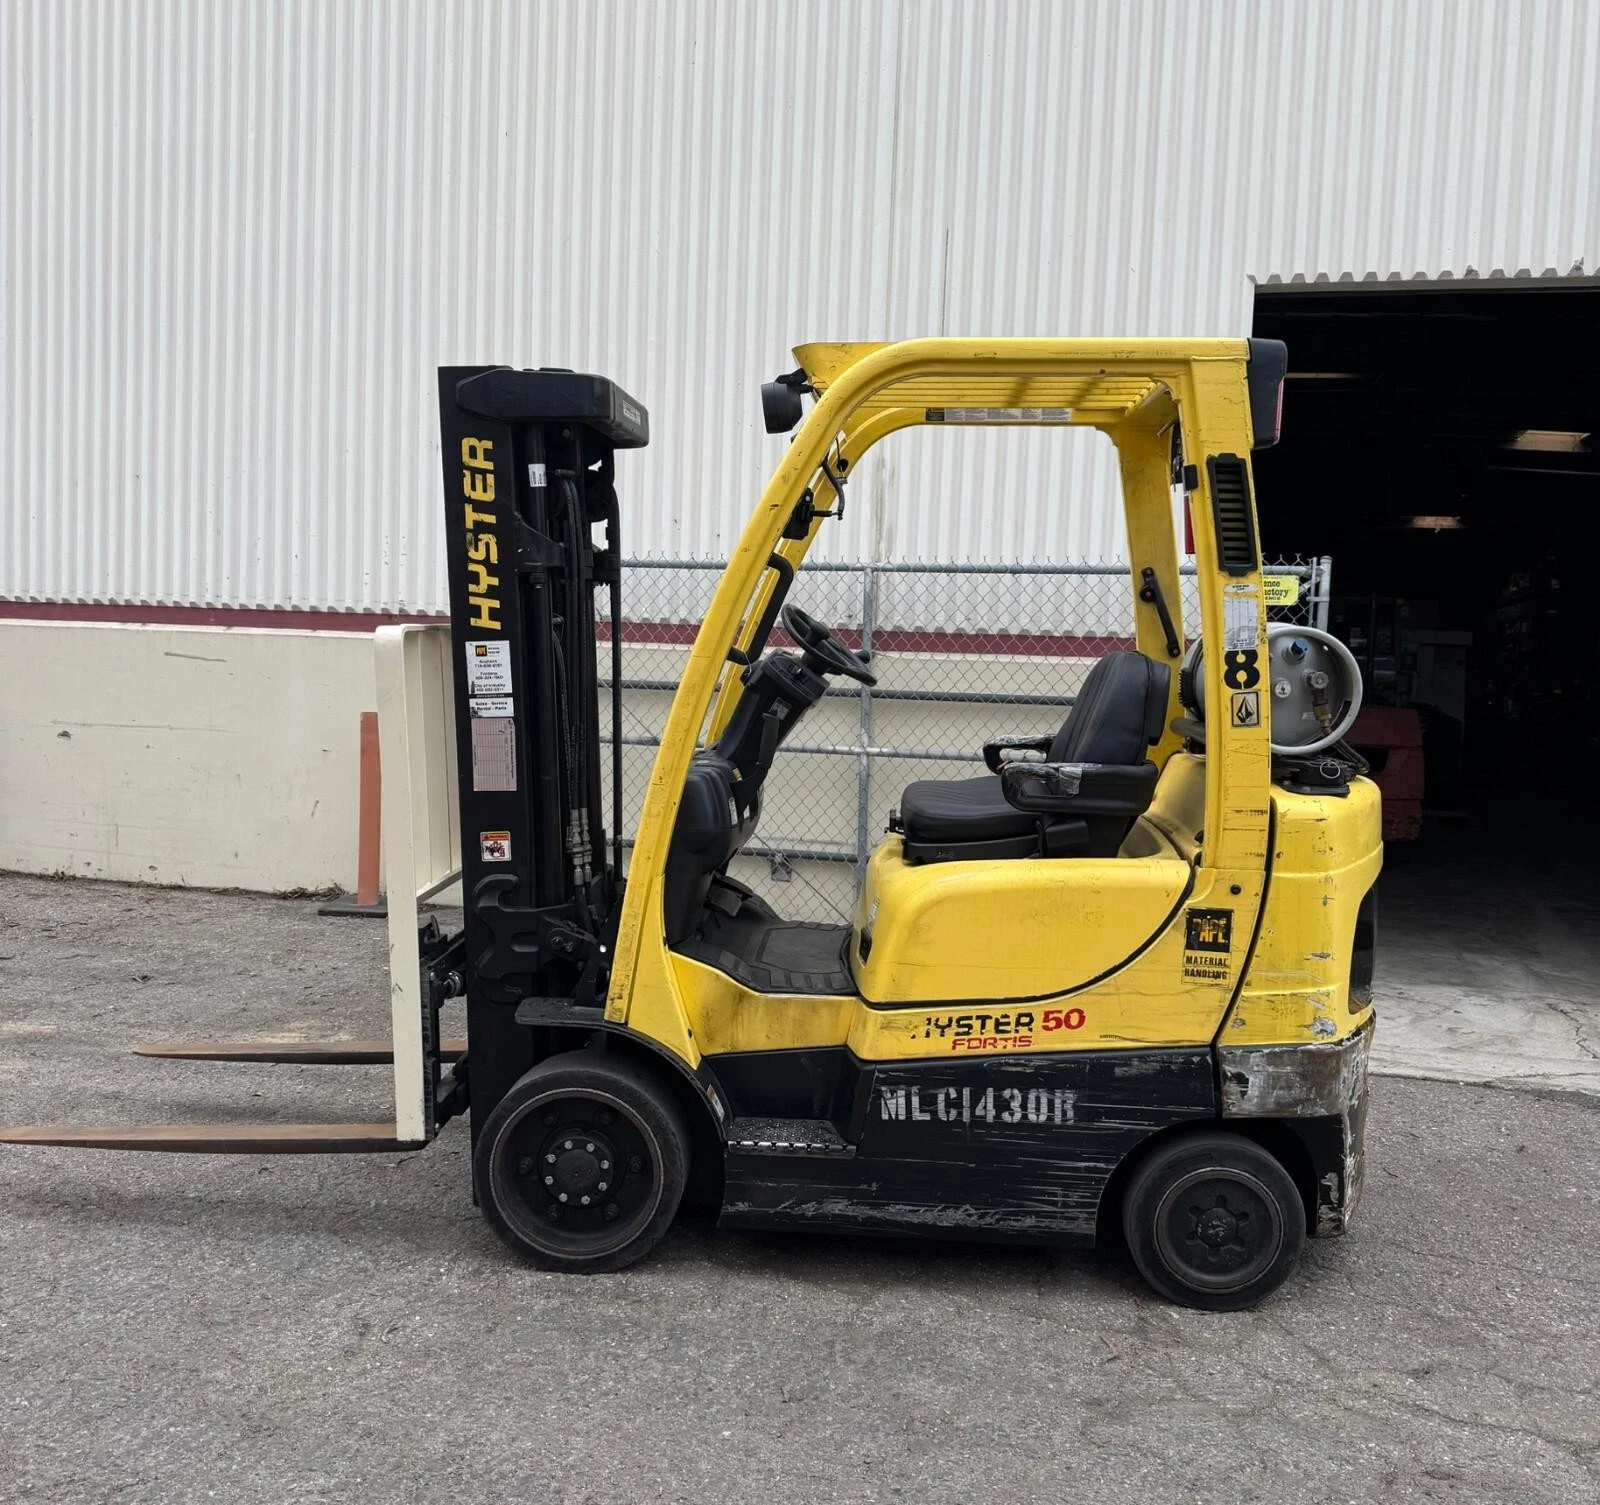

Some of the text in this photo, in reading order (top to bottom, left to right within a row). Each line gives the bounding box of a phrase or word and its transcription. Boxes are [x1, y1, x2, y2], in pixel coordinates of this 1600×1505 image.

[461, 436, 502, 630] HYSTER
[1224, 650, 1260, 689] 8
[1185, 956, 1228, 966] MATERIAL
[1184, 968, 1228, 980] HANDLING
[1041, 1008, 1086, 1031] 50
[951, 1036, 1033, 1050] FORTIS
